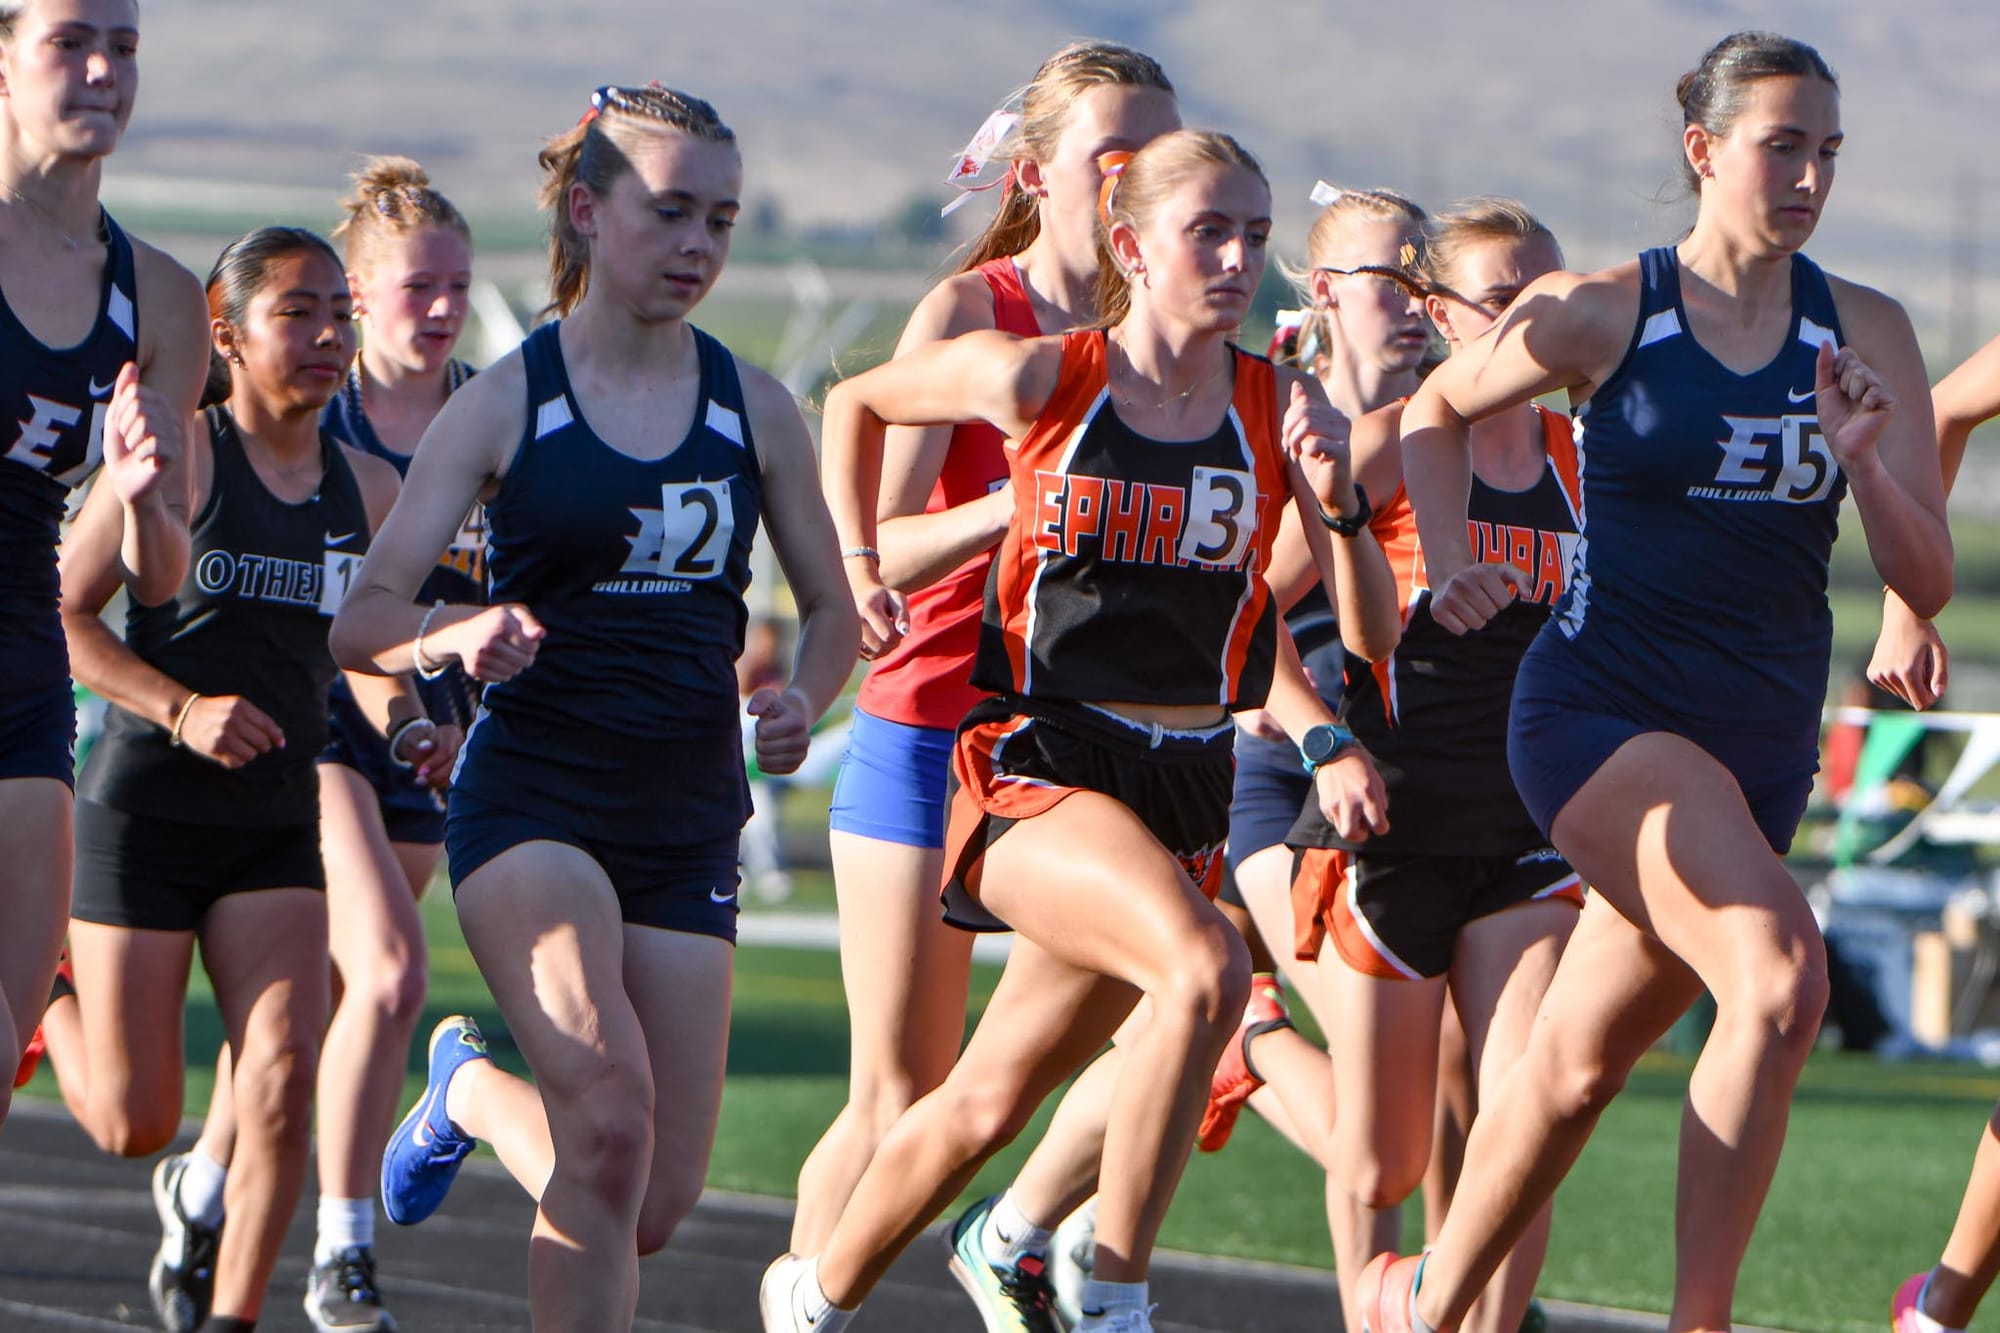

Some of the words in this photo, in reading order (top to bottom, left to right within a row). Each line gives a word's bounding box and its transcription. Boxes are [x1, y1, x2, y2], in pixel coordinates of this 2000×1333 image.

[4, 393, 82, 469] E
[1715, 415, 1782, 483] E
[1788, 422, 1828, 500] 5
[674, 487, 719, 573] 2
[1194, 474, 1244, 562] 3
